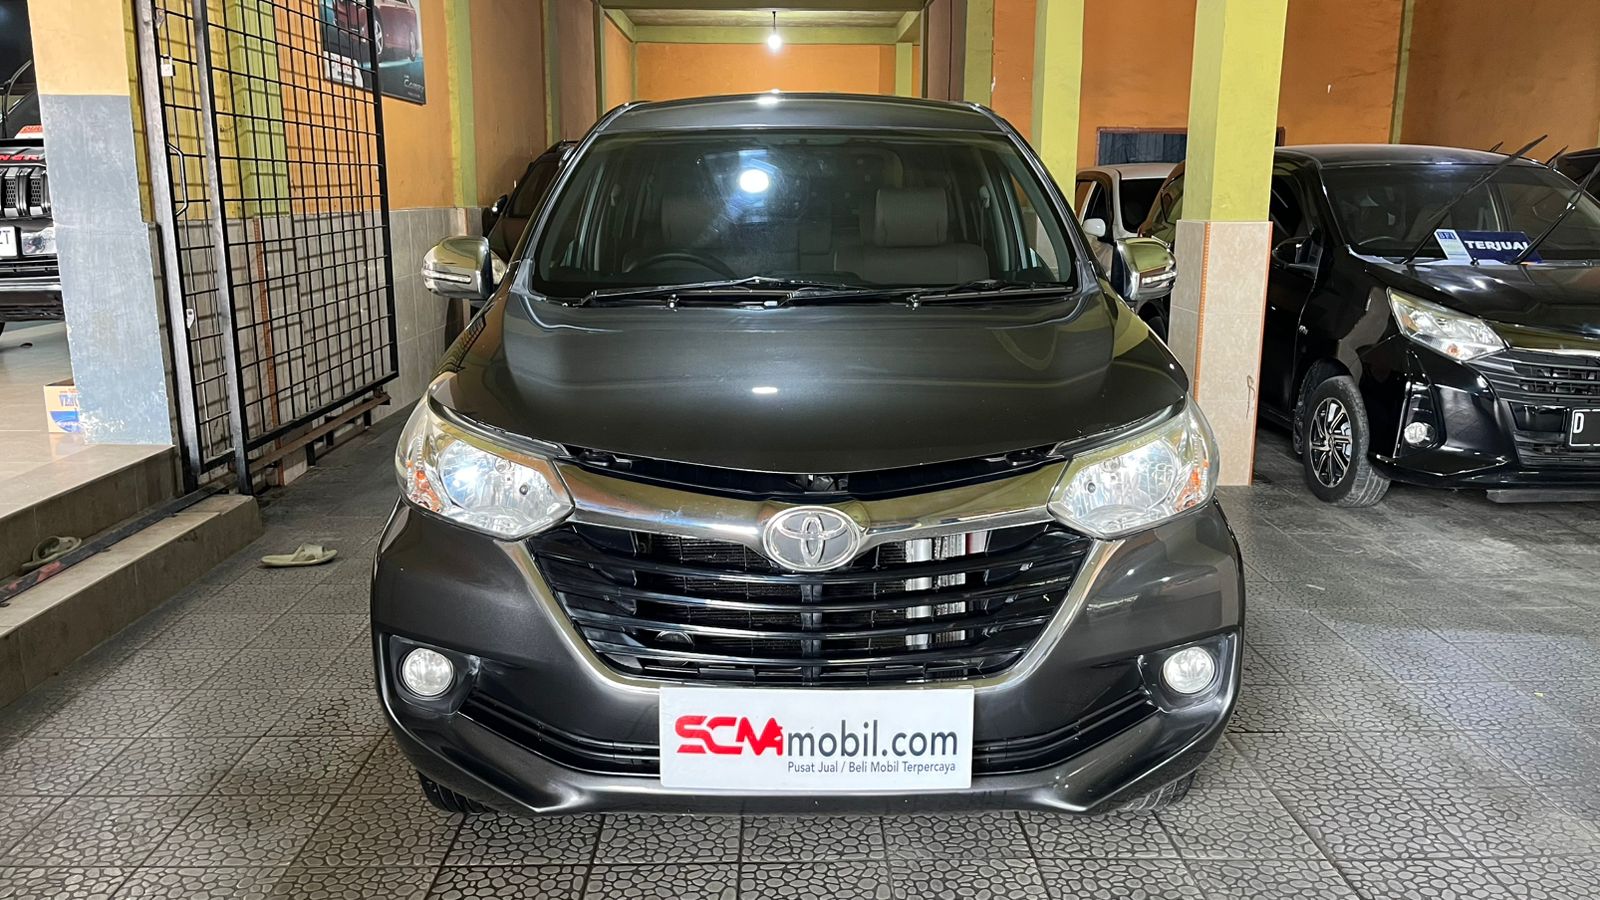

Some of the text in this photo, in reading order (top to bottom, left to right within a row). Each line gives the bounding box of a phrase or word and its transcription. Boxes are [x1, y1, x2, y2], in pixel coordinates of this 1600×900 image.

[1438, 232, 1455, 240] BFI
[1573, 412, 1585, 434] D
[787, 761, 956, 774] Pusat Jual / Beli Mobil Terpercaya
